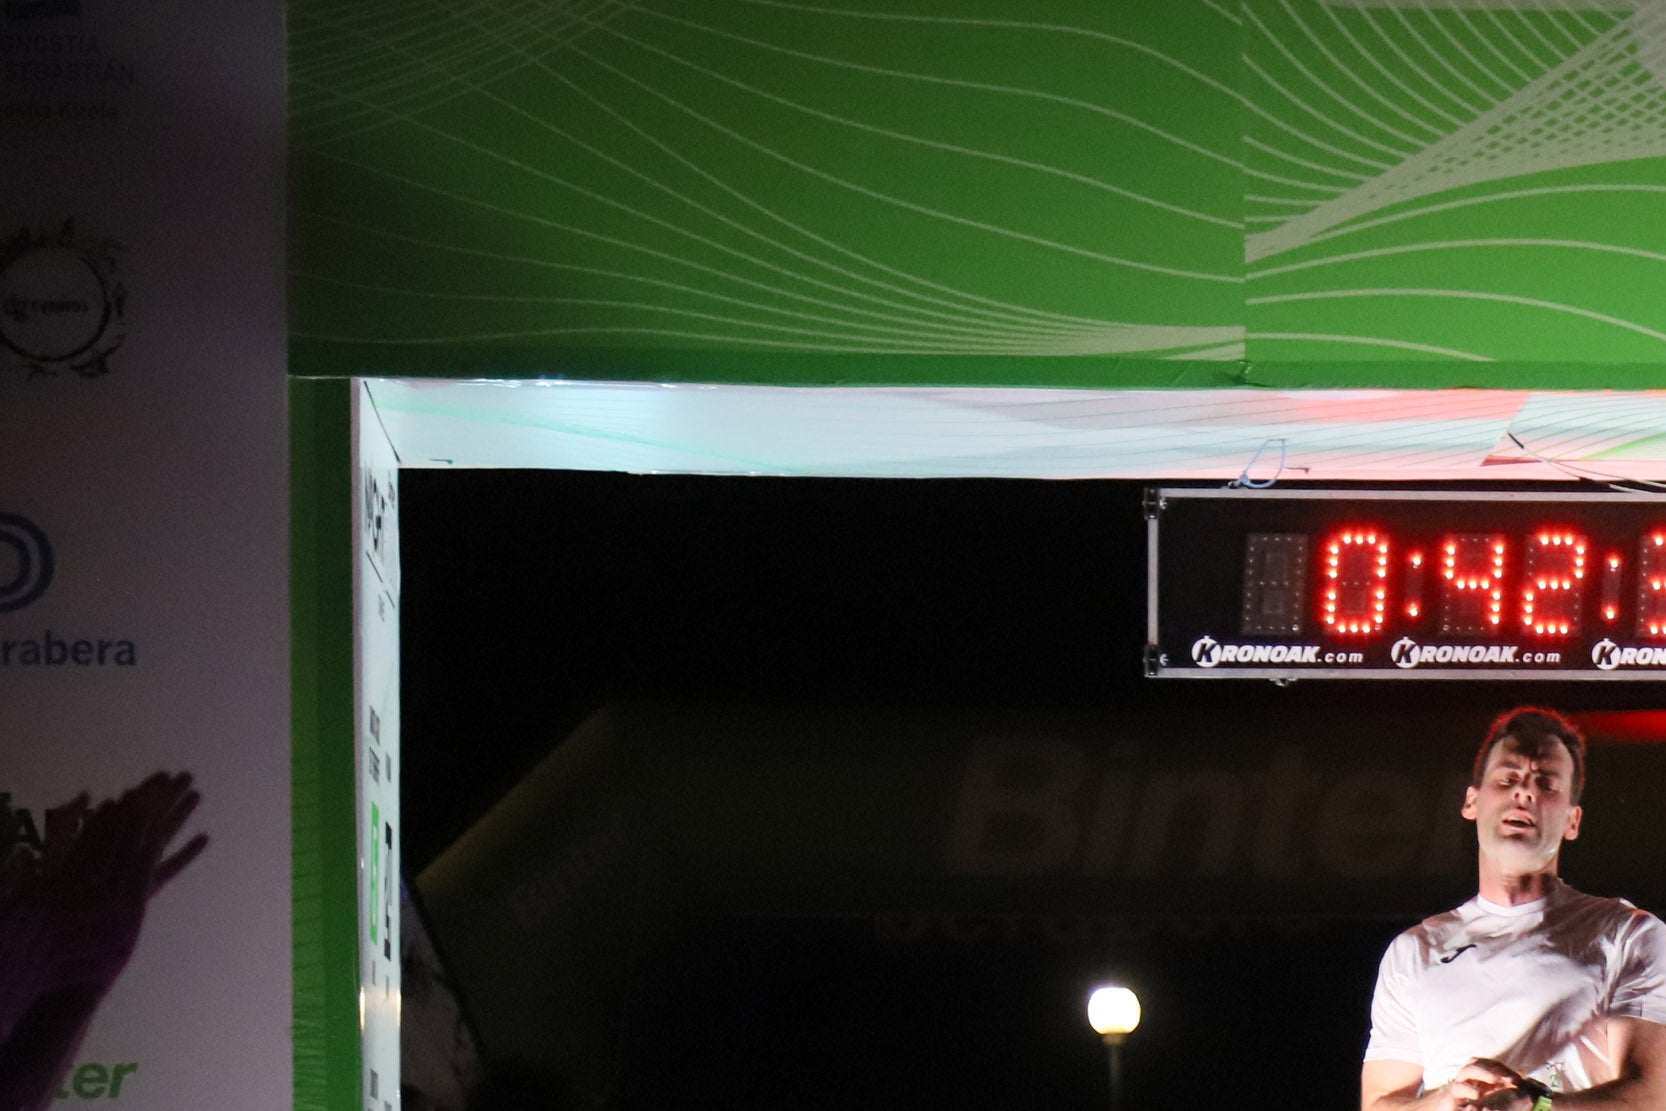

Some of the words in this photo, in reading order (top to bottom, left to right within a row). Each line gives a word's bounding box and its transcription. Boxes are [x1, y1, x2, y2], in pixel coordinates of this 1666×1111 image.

[0, 630, 137, 667] rabera
[1191, 635, 1364, 668] KRONOAK.com
[1391, 636, 1561, 669] KRONOAK.com
